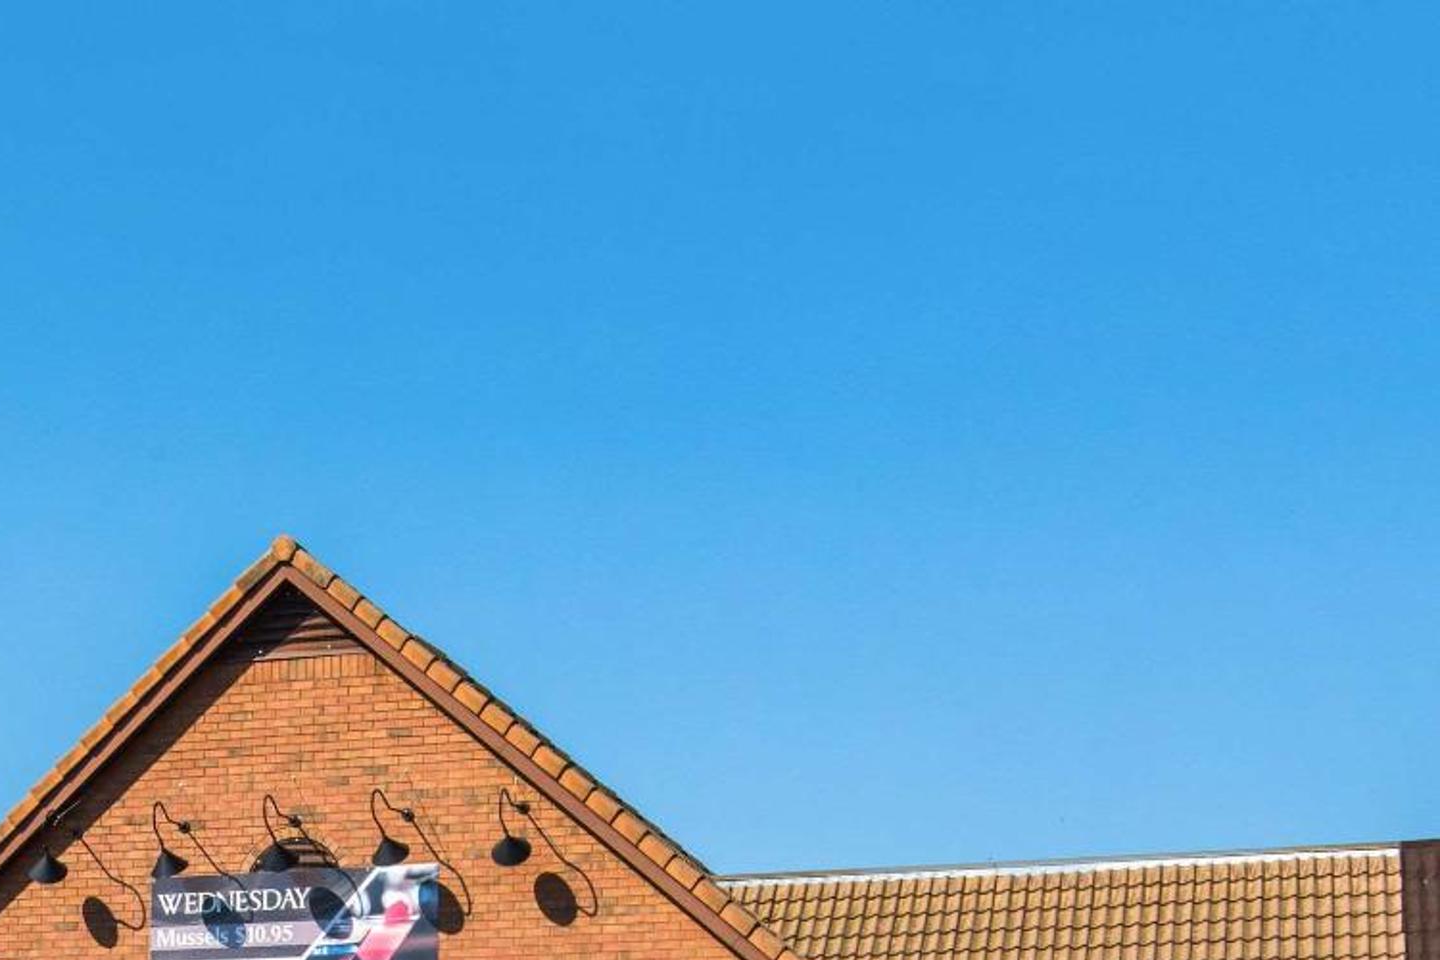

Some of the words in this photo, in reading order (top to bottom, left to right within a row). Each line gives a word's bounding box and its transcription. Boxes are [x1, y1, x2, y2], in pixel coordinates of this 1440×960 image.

[158, 887, 311, 915] WEDNESDAY
[156, 923, 228, 947] Mussels
[235, 924, 293, 945] $10.95
